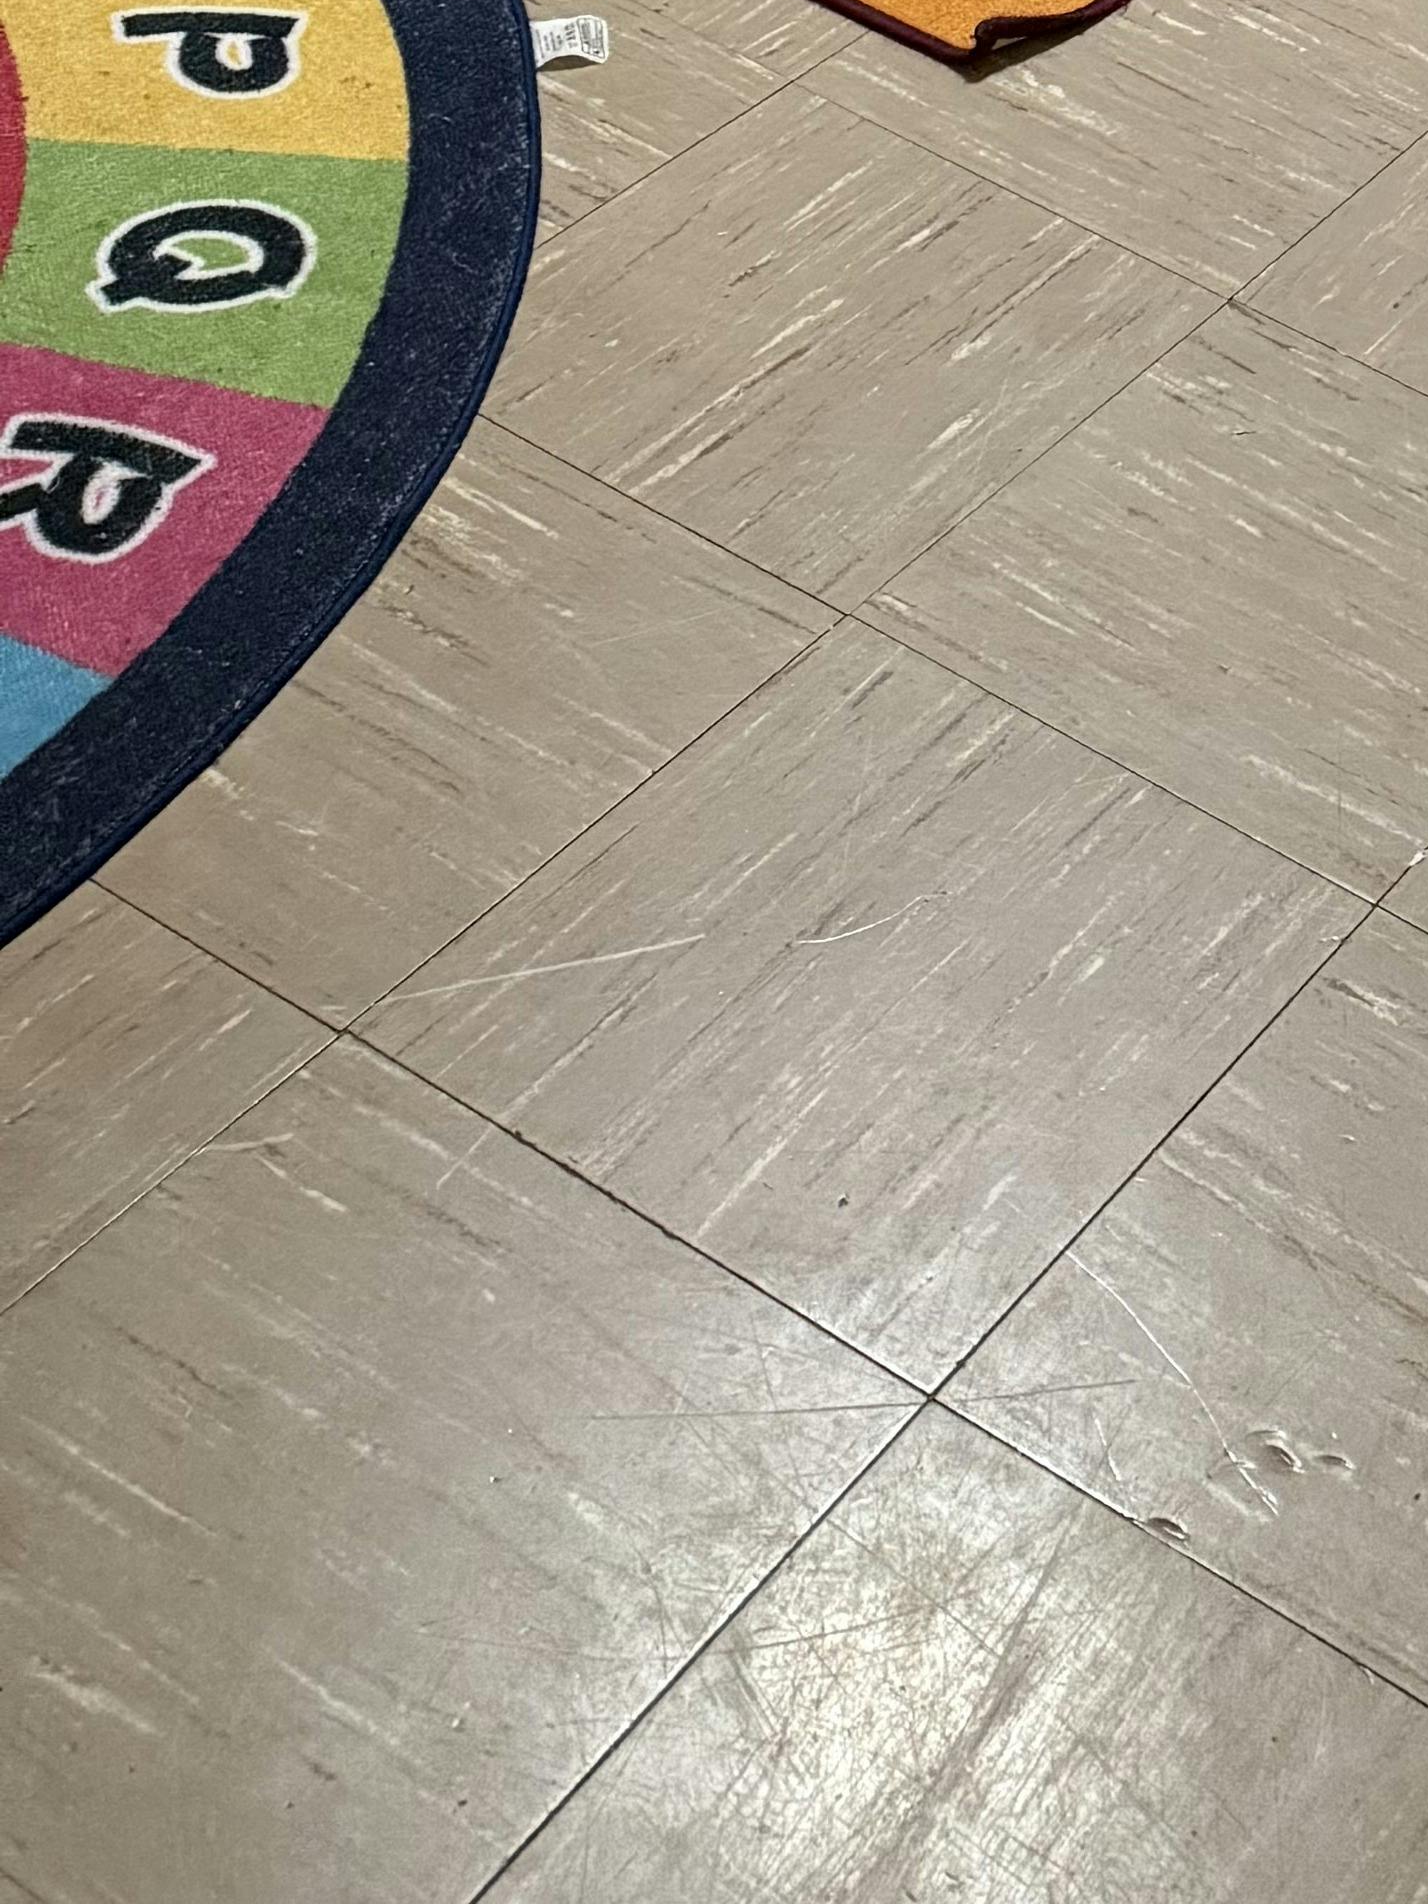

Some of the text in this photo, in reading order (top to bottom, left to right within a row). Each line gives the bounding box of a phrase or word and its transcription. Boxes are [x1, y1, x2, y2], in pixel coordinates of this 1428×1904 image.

[112, 6, 308, 100] P
[86, 196, 320, 316] Q
[0, 412, 219, 563] R
